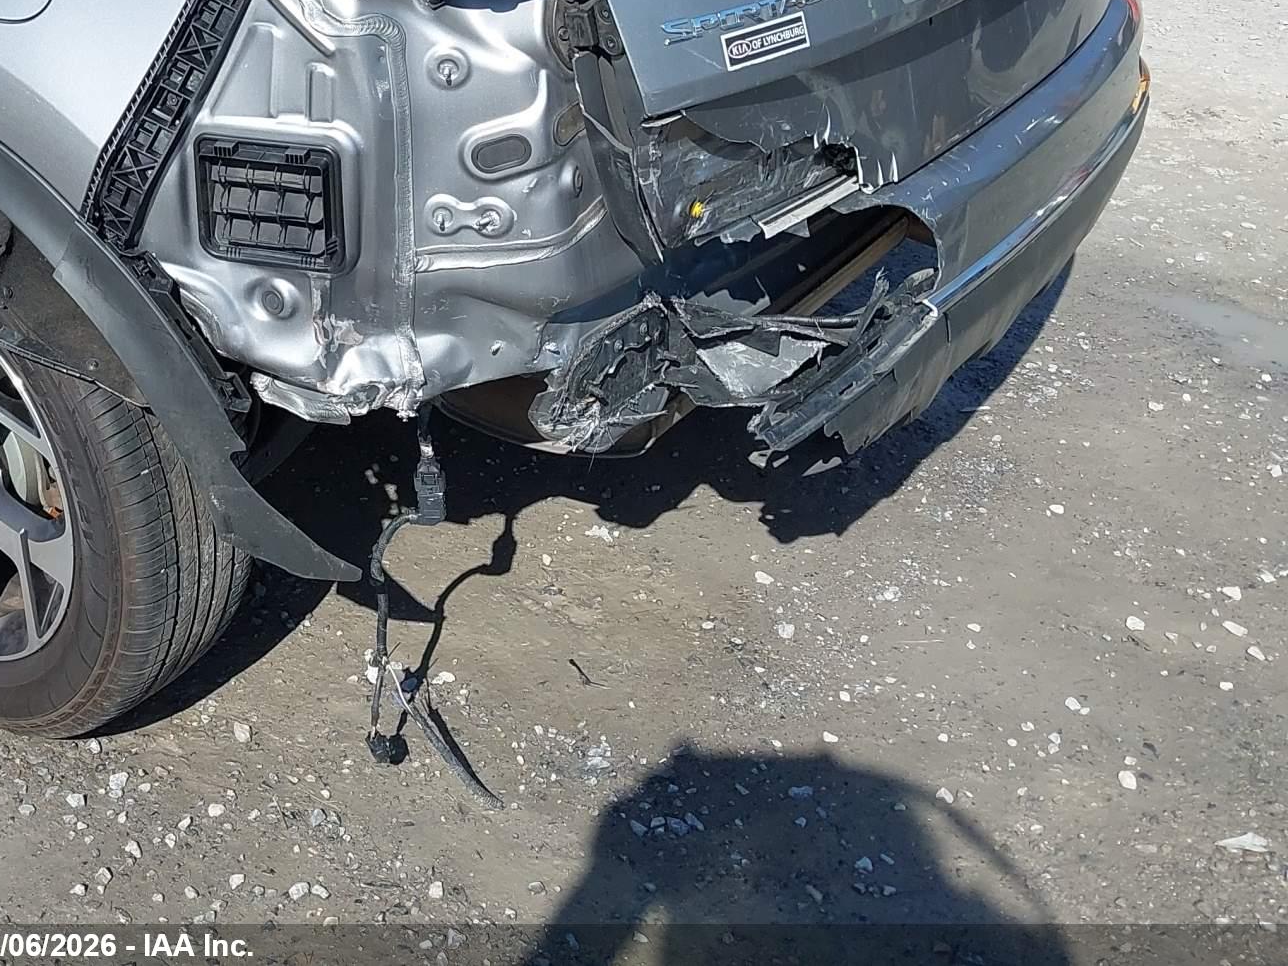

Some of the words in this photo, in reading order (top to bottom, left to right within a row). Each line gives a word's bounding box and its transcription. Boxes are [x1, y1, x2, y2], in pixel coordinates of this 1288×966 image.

[732, 42, 749, 56] KIA
[752, 38, 763, 50] OF
[762, 25, 805, 46] LYNCHBURG
